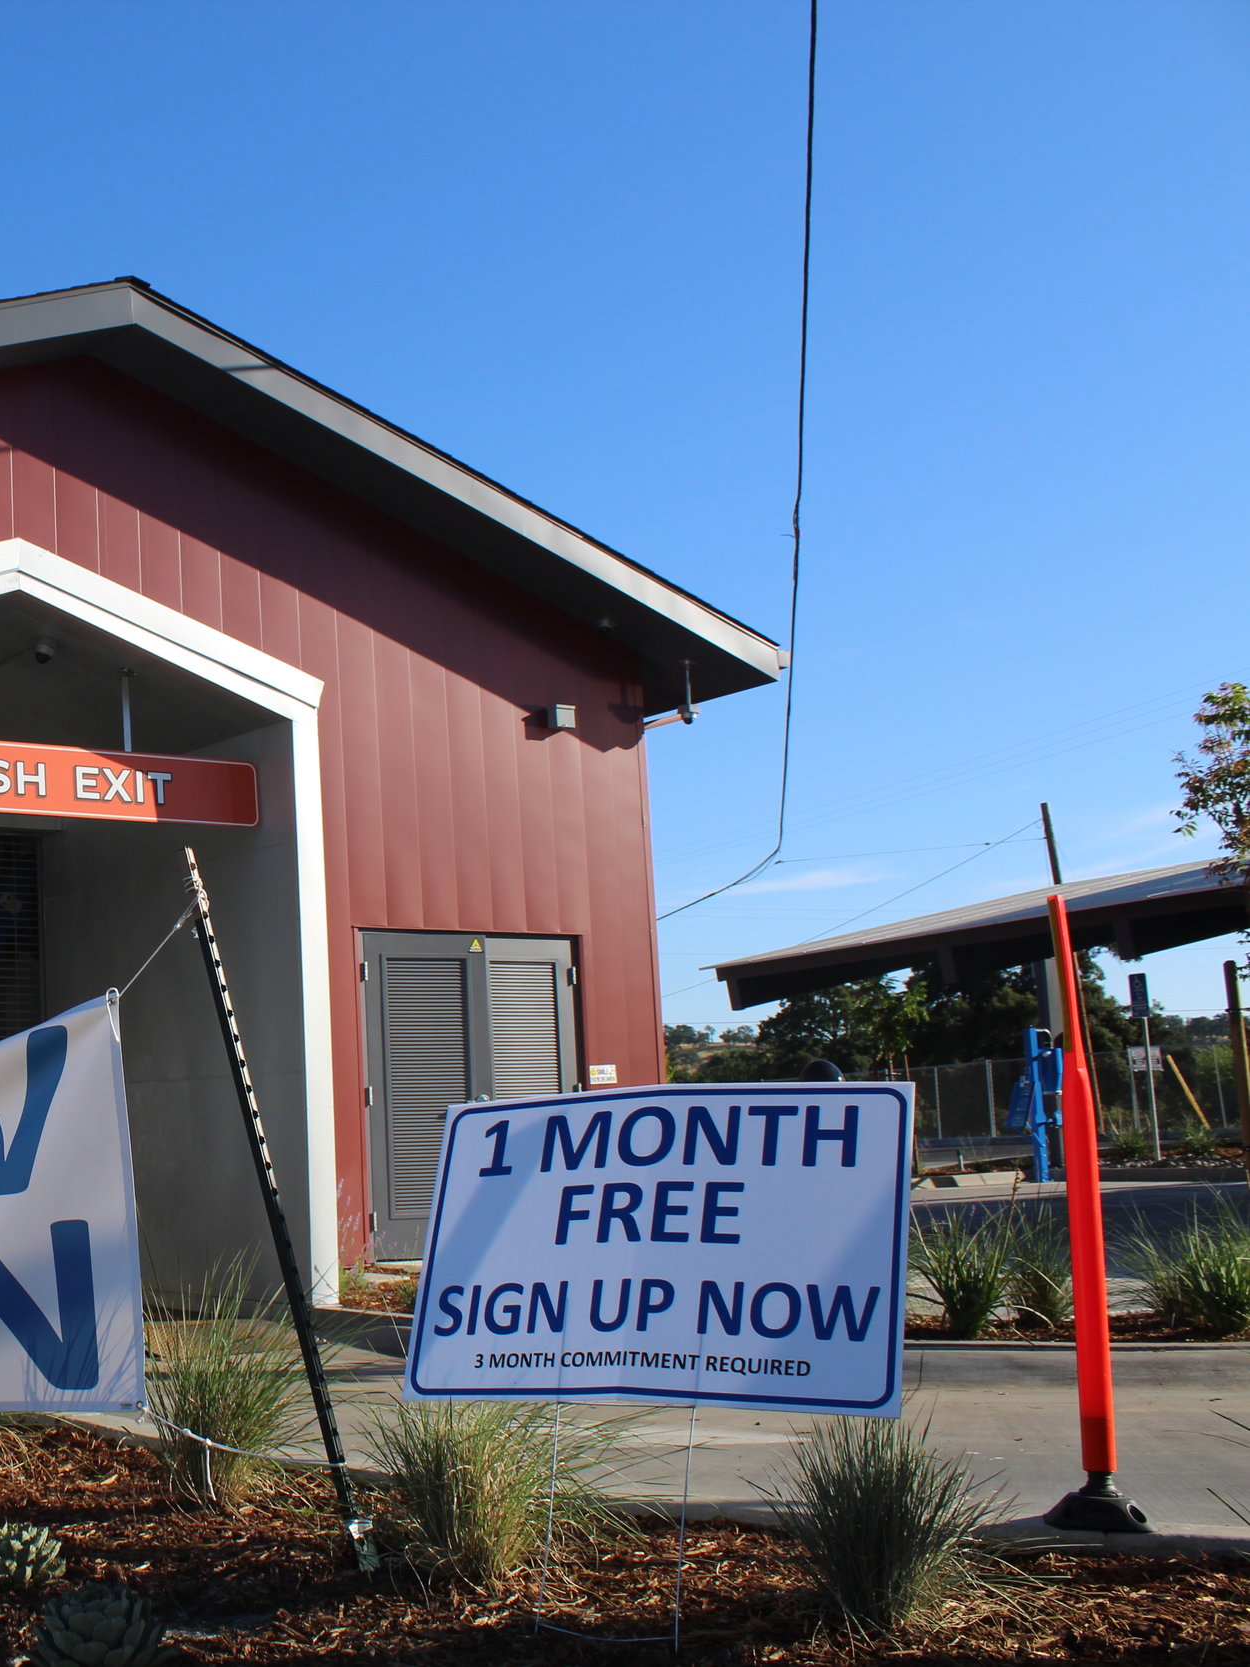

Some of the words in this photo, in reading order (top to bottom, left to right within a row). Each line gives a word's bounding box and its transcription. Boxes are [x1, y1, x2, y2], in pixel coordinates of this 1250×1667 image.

[74, 765, 173, 805] EXIT
[478, 1119, 513, 1178] 1
[540, 1104, 860, 1173] MONTH
[554, 1180, 745, 1246] FREE
[434, 1280, 568, 1337] SIGN
[589, 1278, 675, 1332] UP
[696, 1280, 881, 1342] NOW
[474, 1353, 484, 1369] 3
[489, 1352, 556, 1369] MONTH
[560, 1350, 700, 1371] COMMITMENT
[705, 1355, 812, 1377] REQUIRED
